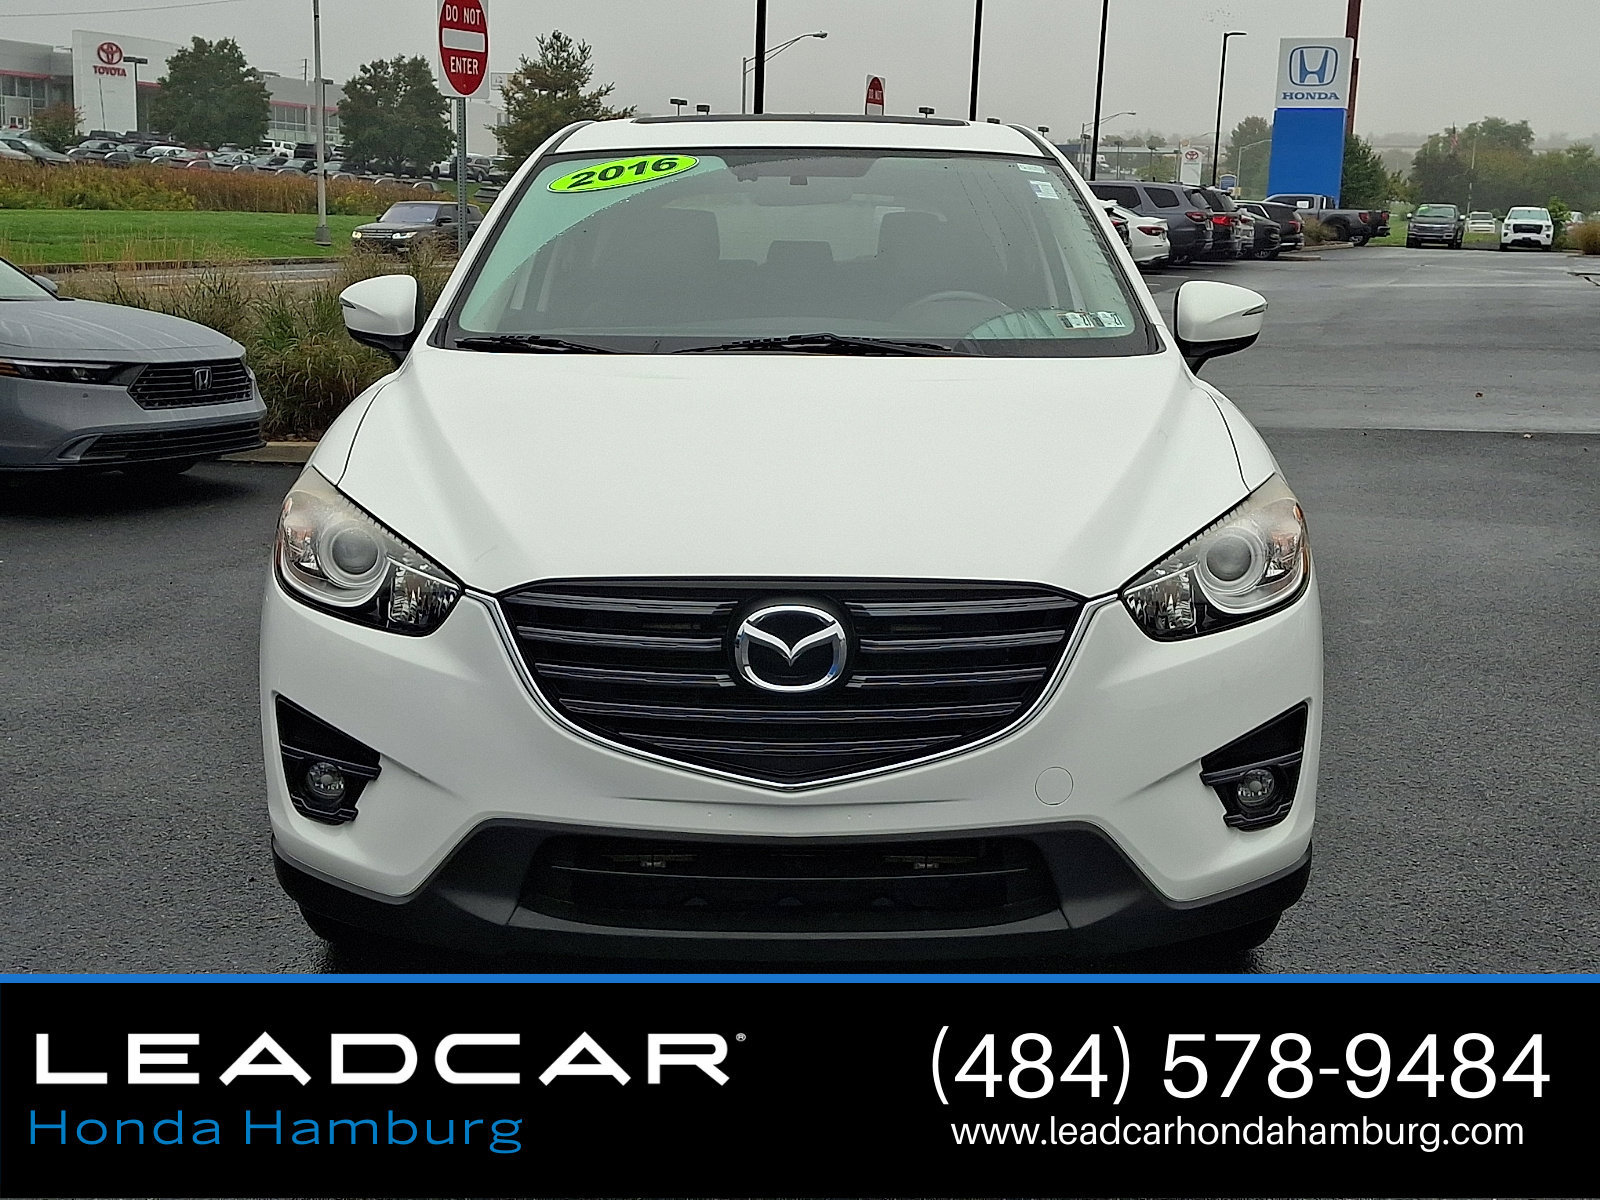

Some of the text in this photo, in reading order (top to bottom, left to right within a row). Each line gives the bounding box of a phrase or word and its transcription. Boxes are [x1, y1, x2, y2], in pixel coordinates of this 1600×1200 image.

[445, 4, 481, 25] DO NOT
[92, 65, 127, 77] TOYOTA
[450, 56, 479, 75] ENTER
[1282, 92, 1340, 100] HONDA
[566, 157, 680, 190] 2016
